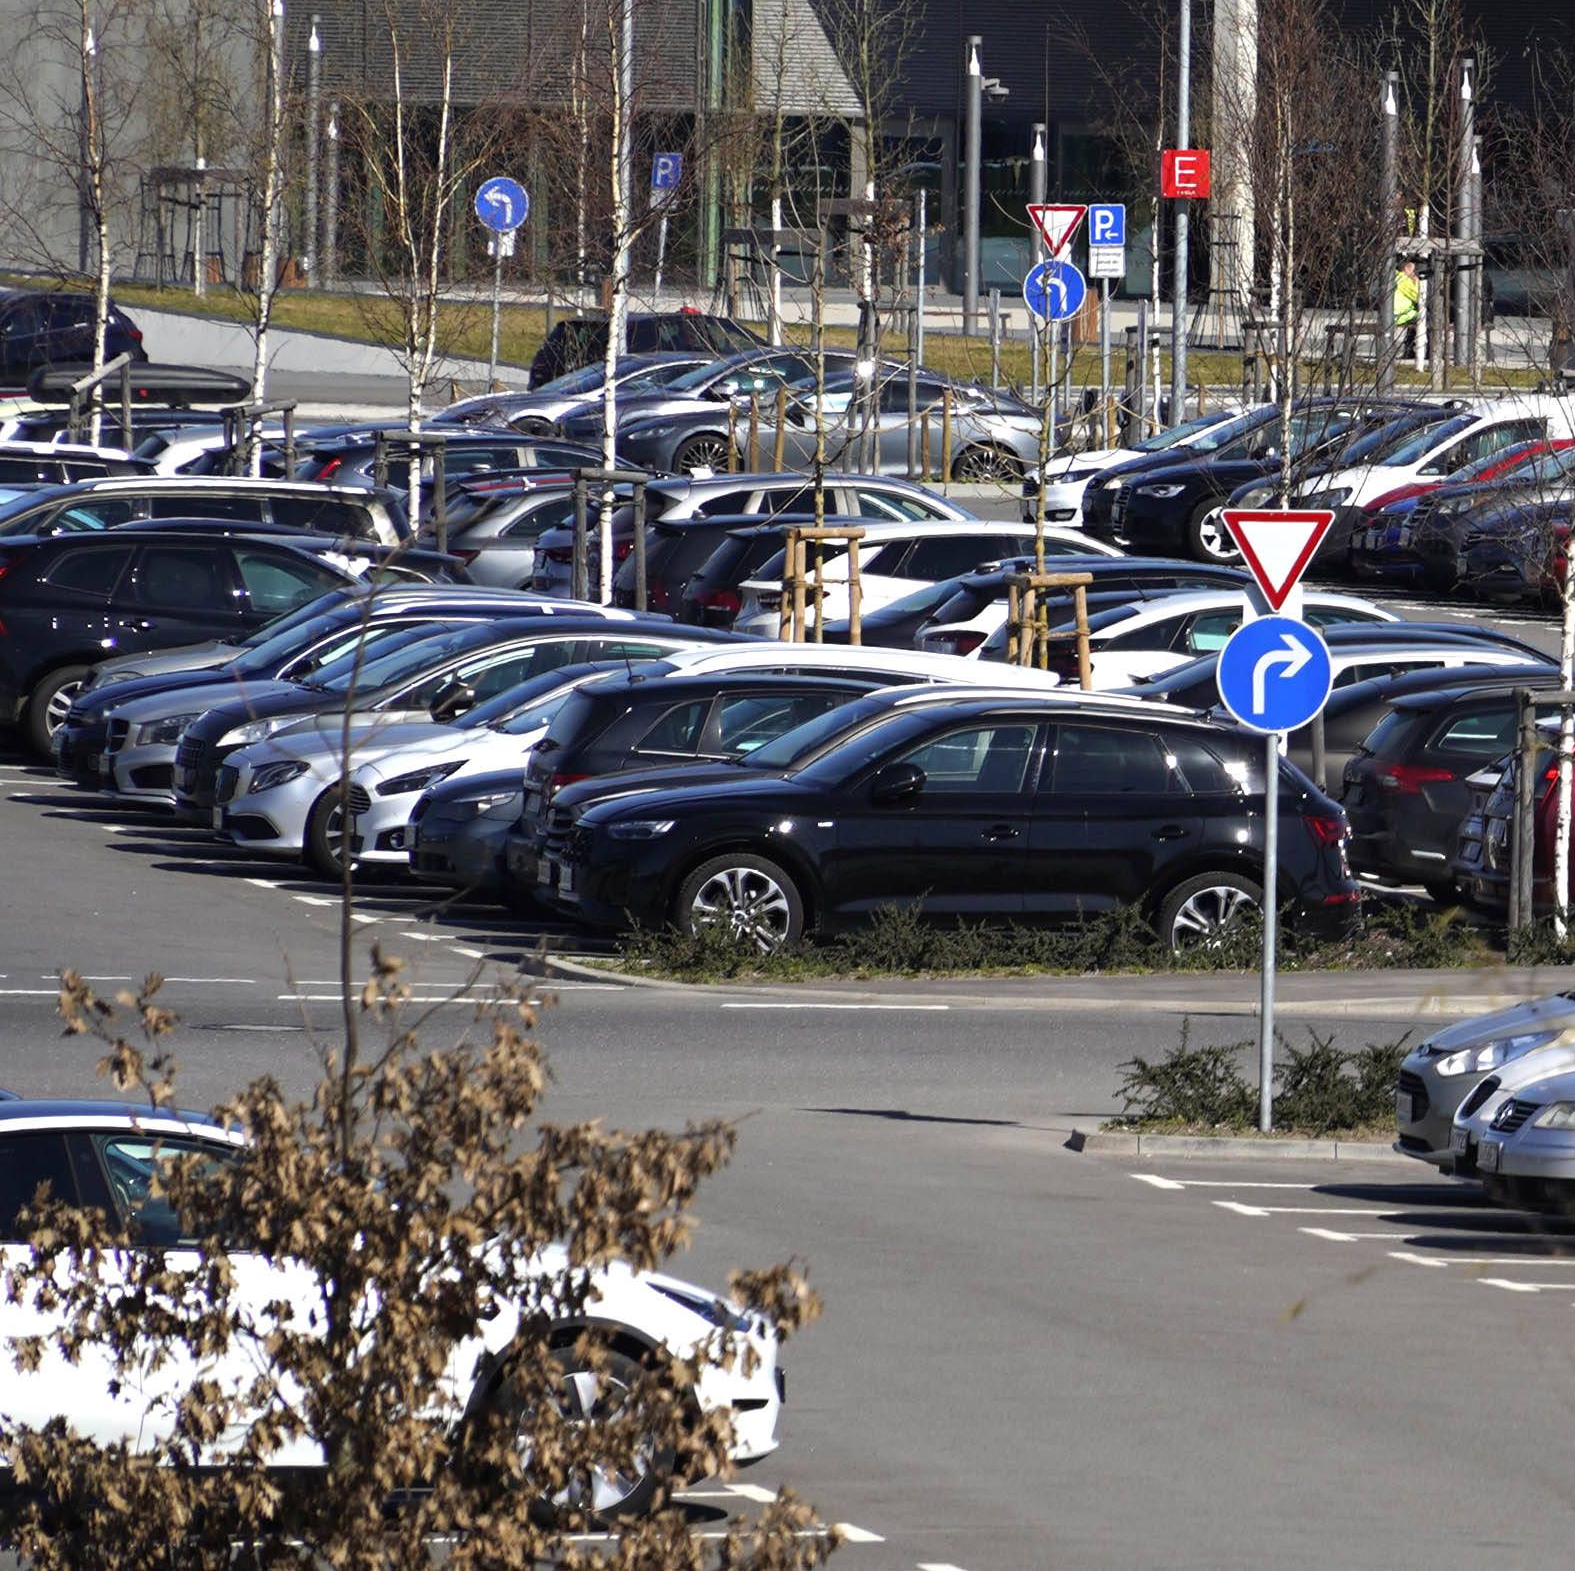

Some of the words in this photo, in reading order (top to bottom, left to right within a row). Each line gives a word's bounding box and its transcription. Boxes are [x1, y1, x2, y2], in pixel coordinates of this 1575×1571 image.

[656, 157, 673, 184] P
[1174, 156, 1197, 187] E
[1094, 210, 1114, 240] P
